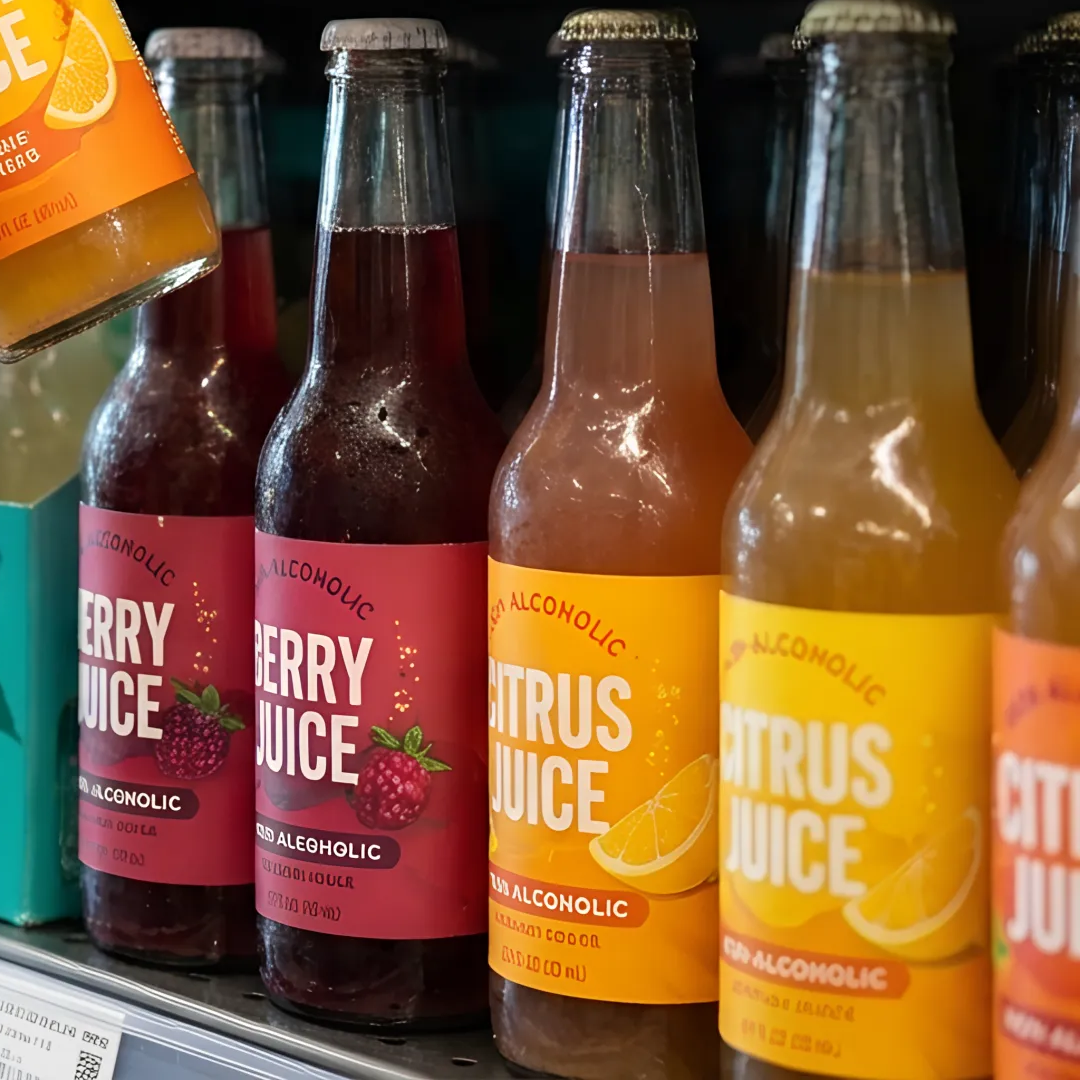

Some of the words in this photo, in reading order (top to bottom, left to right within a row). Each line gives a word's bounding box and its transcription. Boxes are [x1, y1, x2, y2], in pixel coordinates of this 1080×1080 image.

[78, 588, 176, 667] ERRY
[255, 619, 374, 706] BERRY
[255, 699, 359, 786] JUICE
[491, 740, 611, 835] JUICE
[725, 794, 867, 898] JUICE
